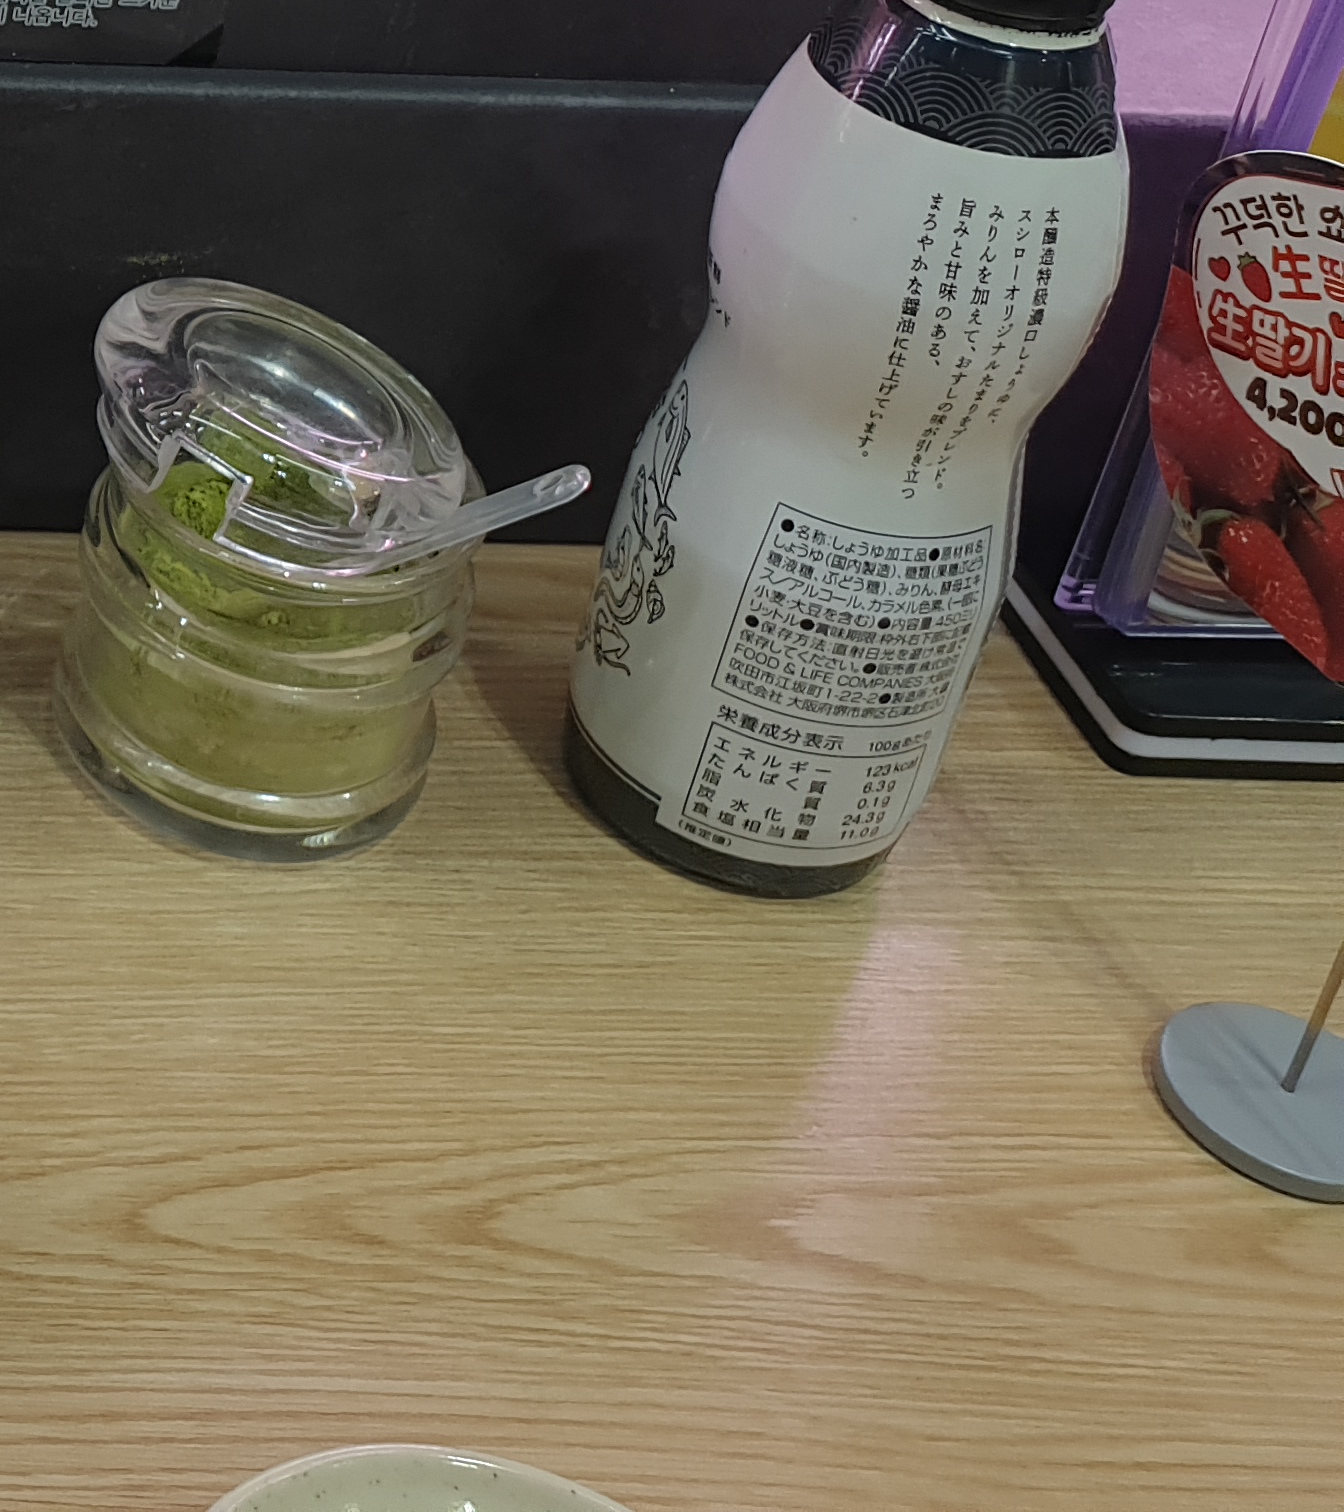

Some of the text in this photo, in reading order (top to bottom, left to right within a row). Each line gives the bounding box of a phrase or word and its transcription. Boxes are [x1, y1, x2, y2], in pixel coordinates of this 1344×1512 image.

[12, 6, 98, 28] 나옵니다.
[1211, 189, 1311, 247] 꾸덕한
[927, 197, 977, 367] 旨みと甘味のある、
[1209, 290, 1344, 399] 生딸기
[734, 643, 834, 685] FOOD & LIFE
[717, 704, 844, 751] 栄養成分表示
[713, 737, 832, 775] エネルギー
